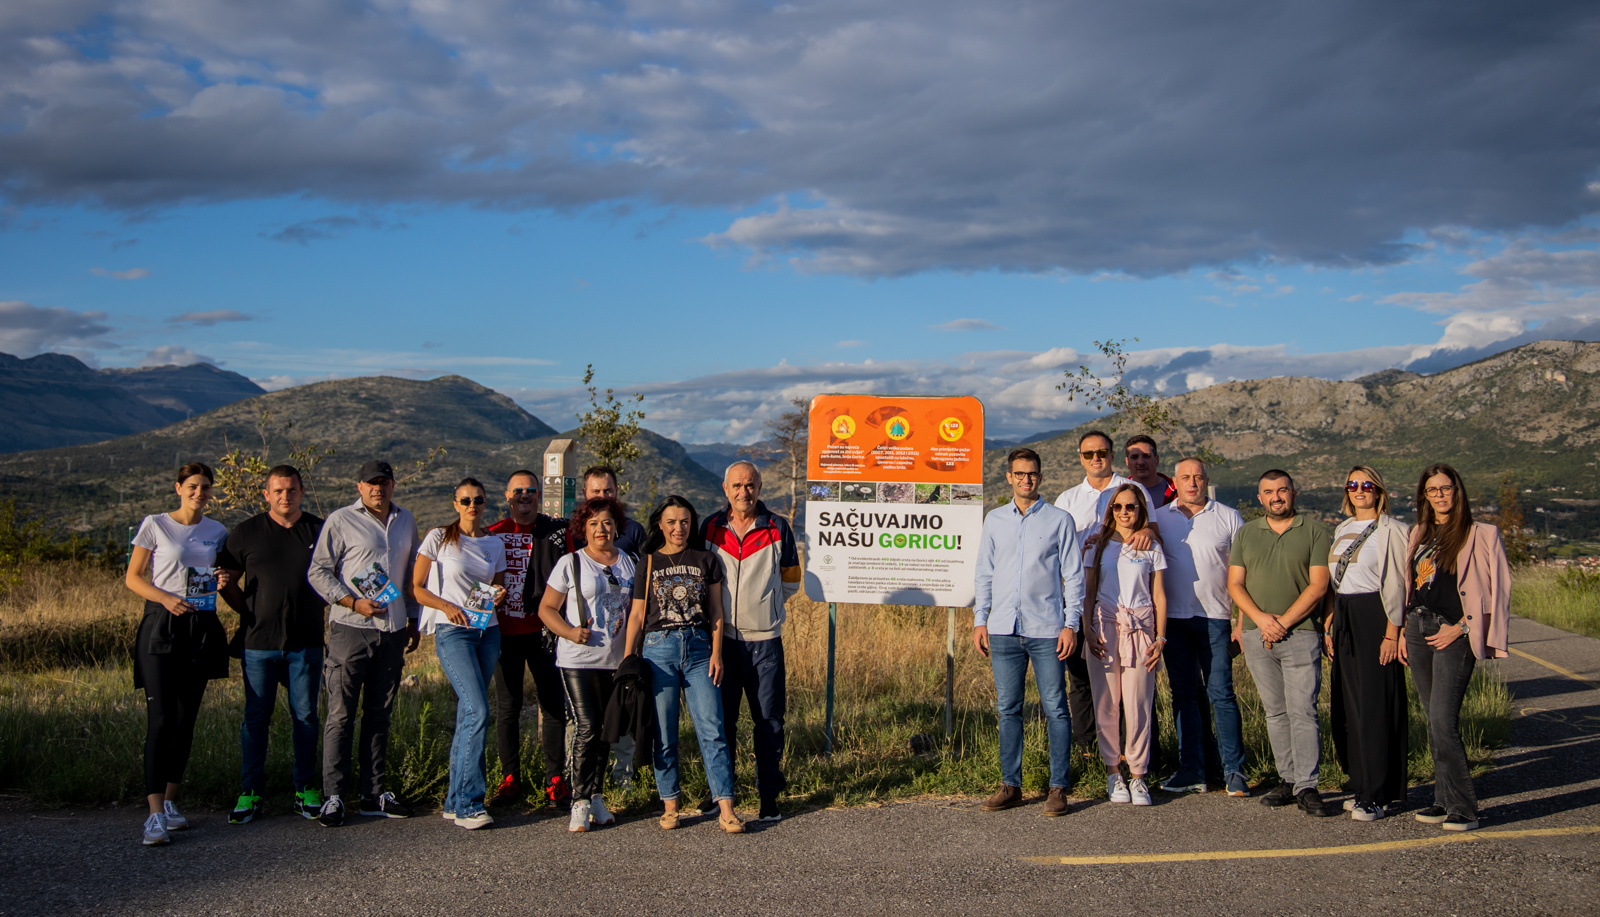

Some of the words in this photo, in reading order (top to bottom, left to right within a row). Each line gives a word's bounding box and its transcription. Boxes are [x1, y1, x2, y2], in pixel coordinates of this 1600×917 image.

[818, 508, 944, 529] SAČUVAJMO
[818, 528, 874, 547] NAŠU
[878, 533, 962, 550] GORICU!
